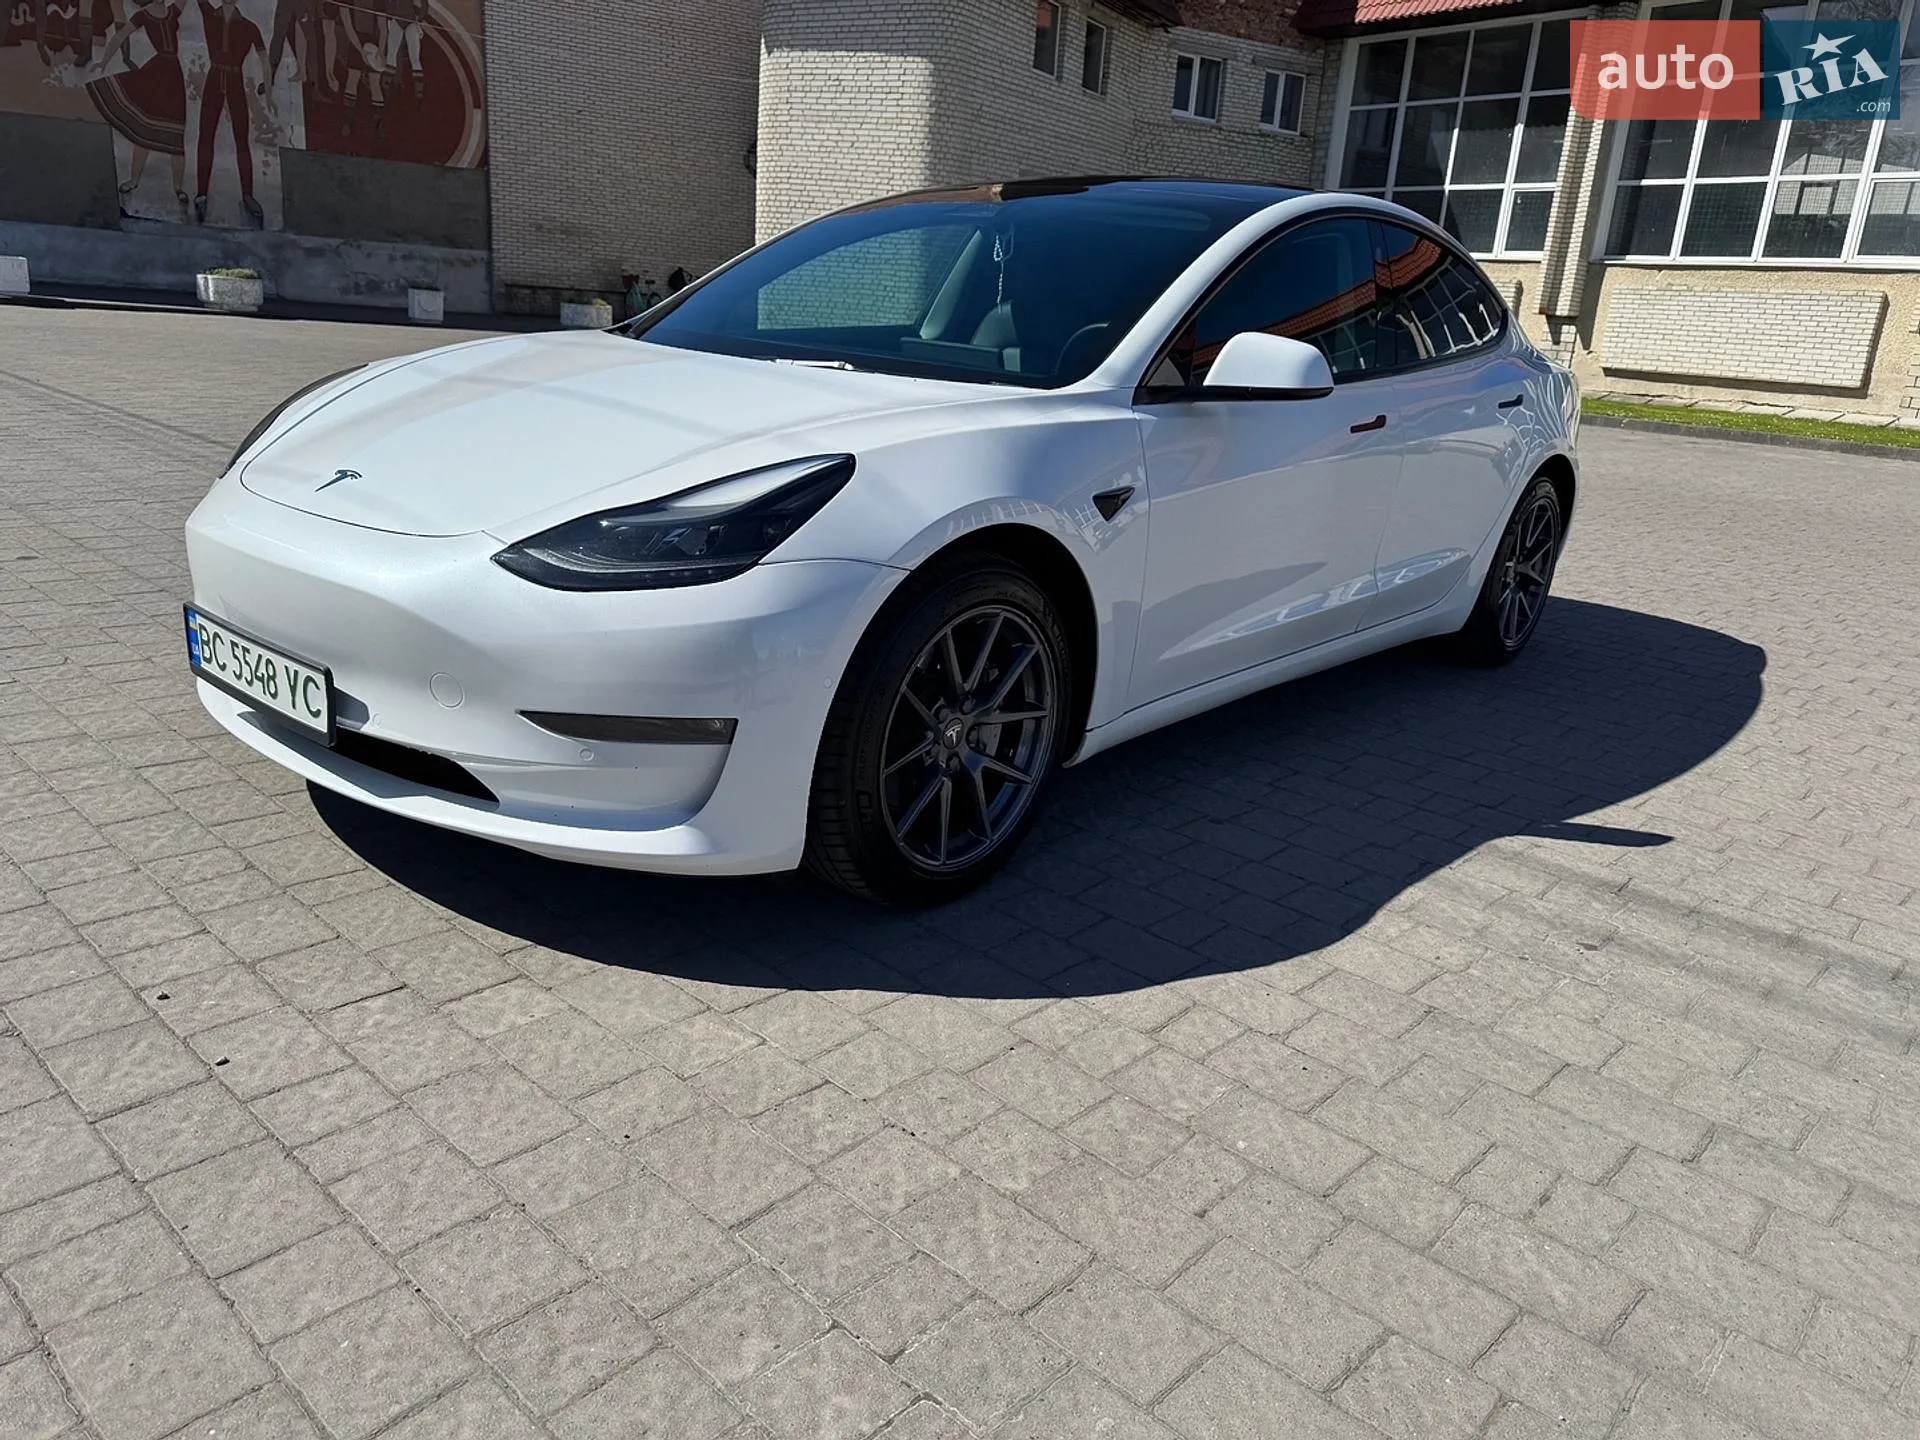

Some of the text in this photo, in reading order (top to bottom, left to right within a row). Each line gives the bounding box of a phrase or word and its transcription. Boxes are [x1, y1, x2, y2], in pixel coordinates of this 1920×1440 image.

[198, 623, 322, 719] BC 5548 YC
